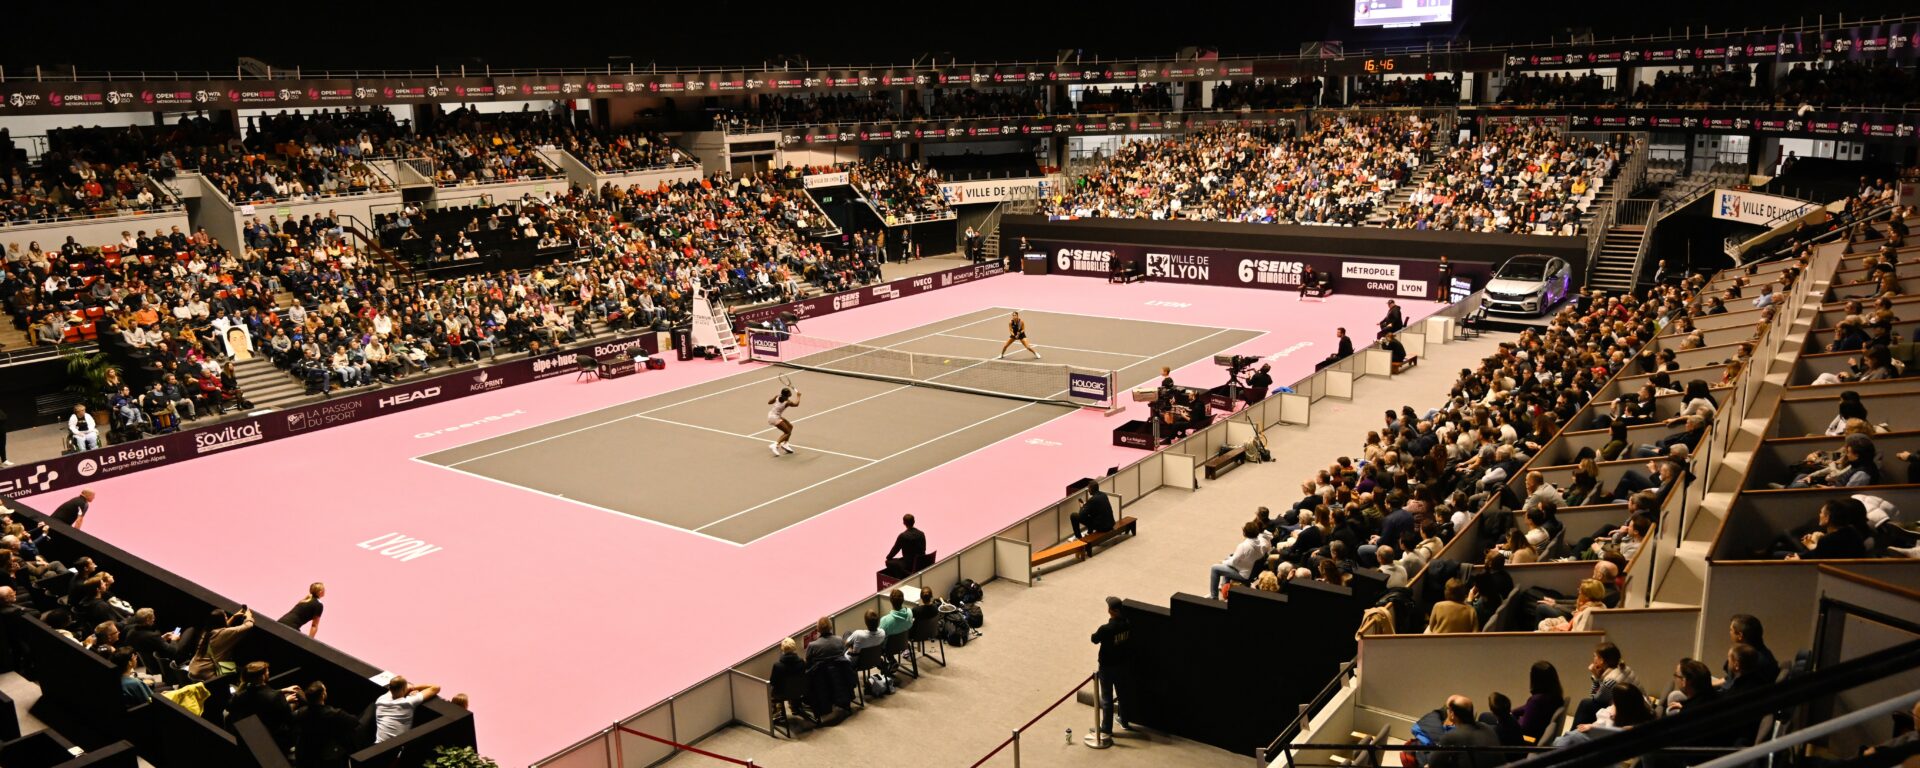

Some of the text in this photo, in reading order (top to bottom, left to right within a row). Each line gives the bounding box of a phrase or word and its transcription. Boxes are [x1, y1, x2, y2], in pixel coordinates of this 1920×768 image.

[1364, 60, 1394, 71] 16:46
[966, 184, 1035, 198] VILLE DE LYON
[1742, 201, 1764, 217] VILLE
[1767, 205, 1777, 218] DE
[1073, 260, 1110, 272] IMMOBILIER
[1171, 254, 1209, 265] VILLE DE
[1171, 266, 1209, 280] LYON
[1346, 266, 1395, 277] MÉTROPOLE
[913, 277, 933, 288] IVECO
[1257, 272, 1301, 285] IMMOBILIER
[1367, 282, 1423, 292] GRAND LYON
[741, 311, 775, 321] SOFITEL
[754, 340, 777, 348] HOLOGIC
[470, 383, 484, 391] AGG
[484, 378, 504, 387] PRINT
[1072, 378, 1105, 391] HOLOGIC
[379, 387, 441, 408] HEAD
[307, 410, 320, 419] LA
[322, 400, 363, 415] PASSION
[308, 418, 323, 428] DU
[325, 410, 356, 424] SPORT
[414, 408, 527, 439] GreenSet
[196, 421, 262, 448] sovitrat
[99, 444, 165, 466] La Région
[355, 532, 444, 562] LYON
